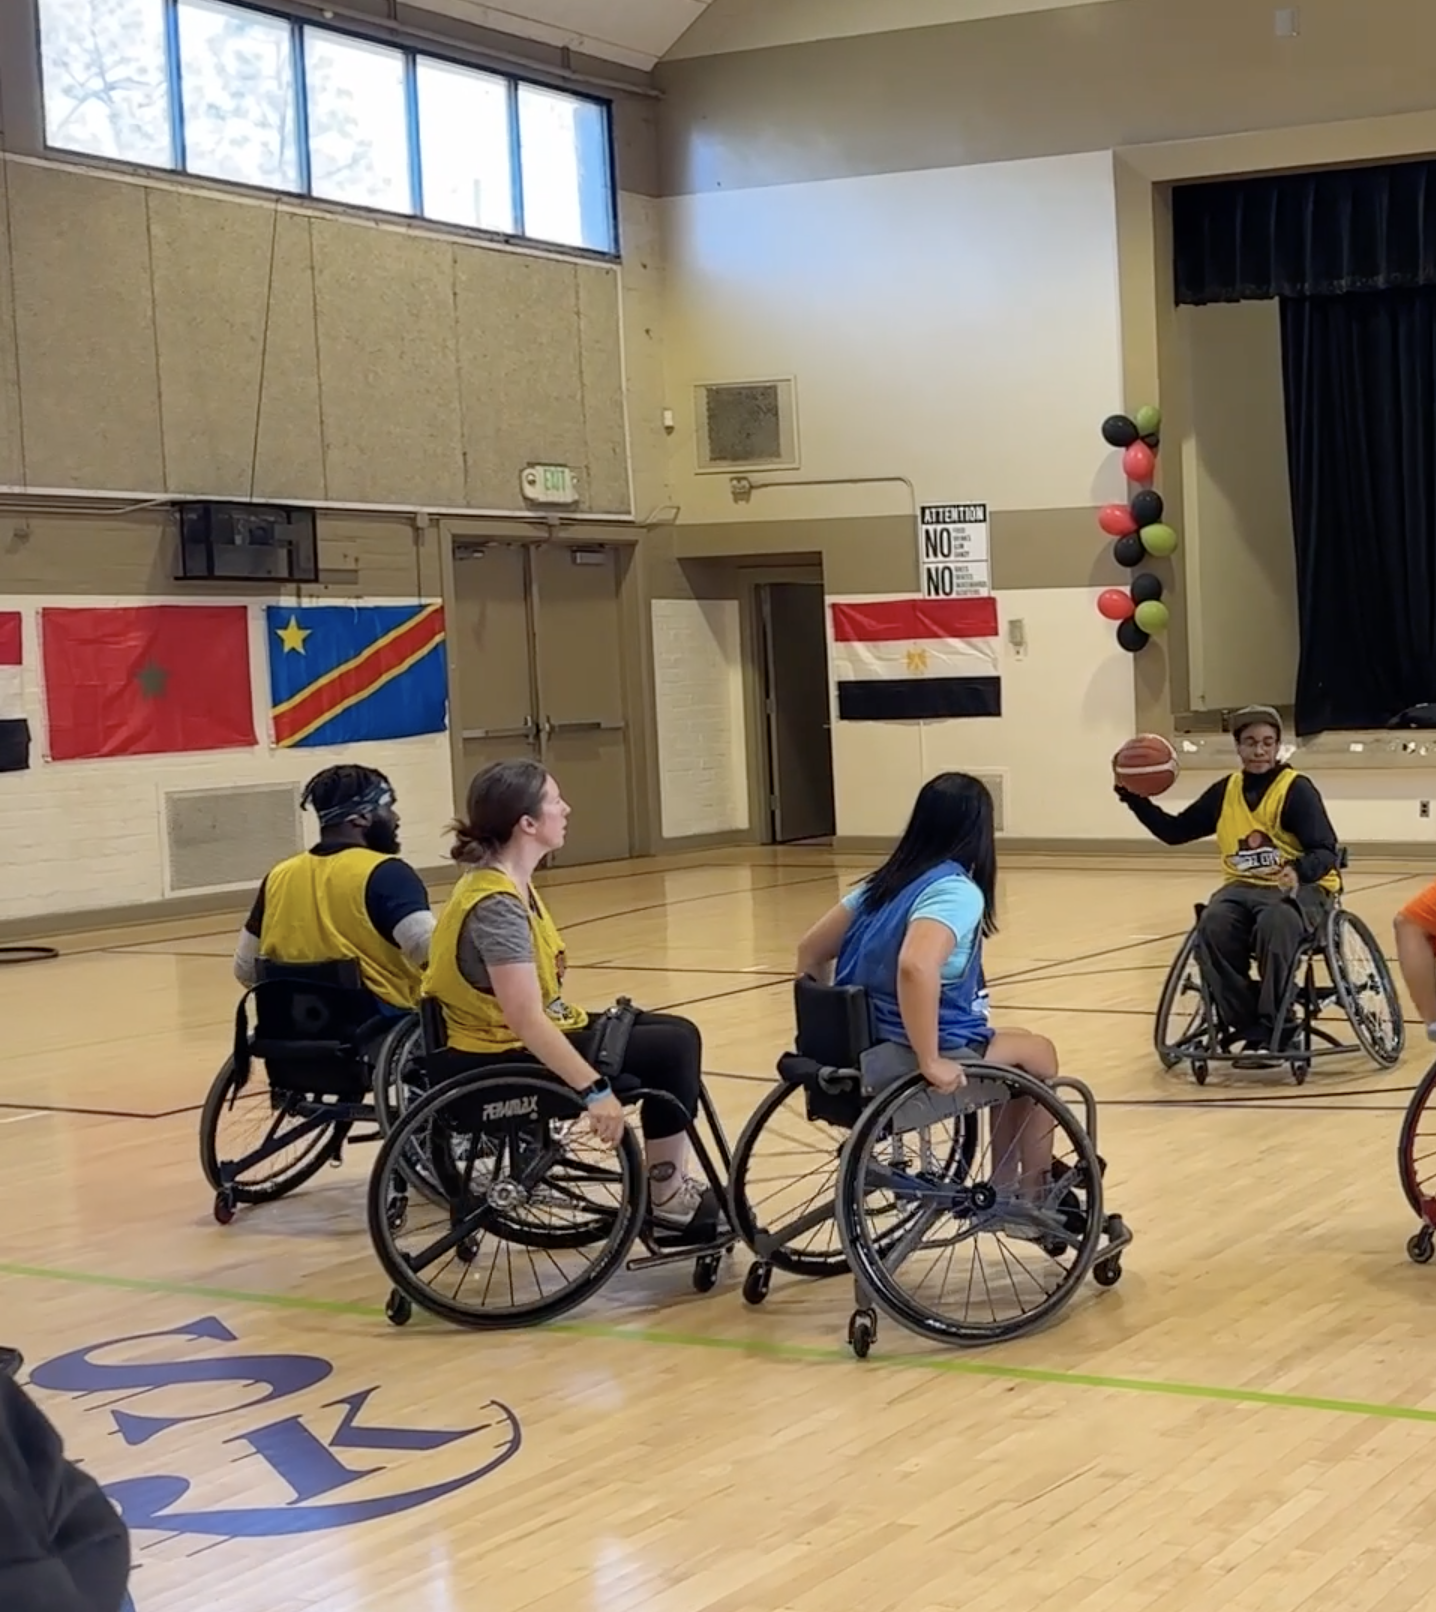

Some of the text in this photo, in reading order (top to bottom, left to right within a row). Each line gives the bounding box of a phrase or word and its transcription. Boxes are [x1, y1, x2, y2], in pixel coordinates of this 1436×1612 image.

[543, 468, 565, 492] EXIT
[923, 505, 985, 523] ATTENTION
[925, 527, 952, 558] NO
[926, 565, 953, 597] NO
